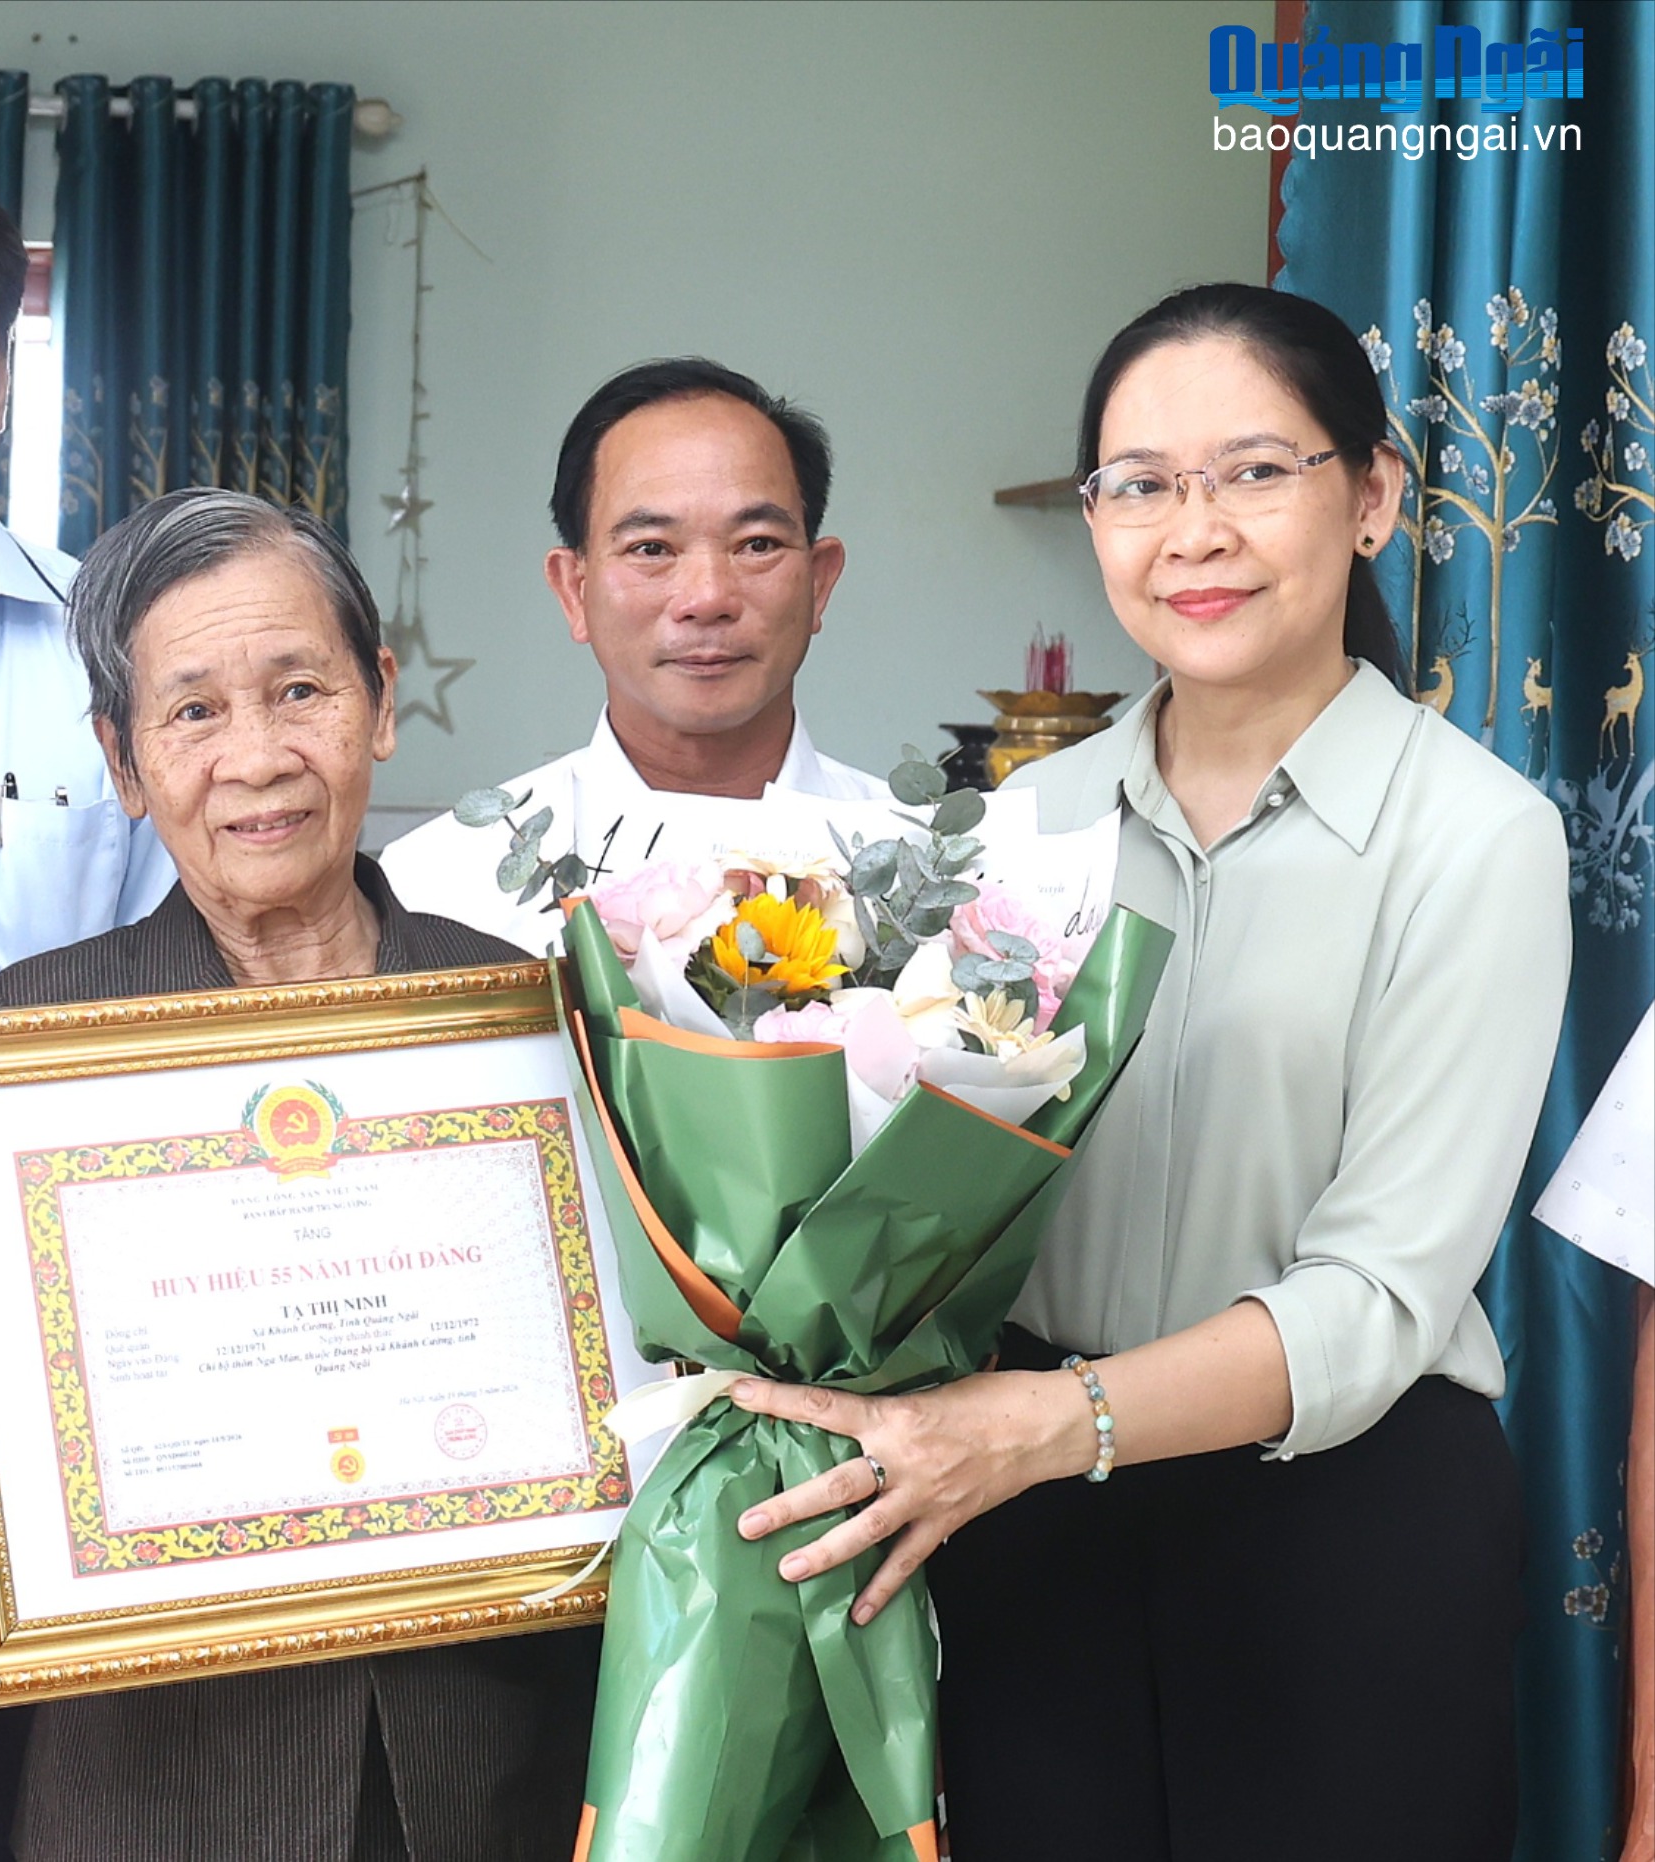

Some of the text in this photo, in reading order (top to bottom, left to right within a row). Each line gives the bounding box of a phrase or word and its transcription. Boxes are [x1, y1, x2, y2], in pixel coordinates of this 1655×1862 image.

[151, 1242, 483, 1298] HUY HIỆU 55 NĂM TUỔI ĐẢNG
[280, 1294, 388, 1321] TẠ THỊ NINH
[430, 1317, 480, 1332] 12/12/1972
[216, 1342, 267, 1356] 12/12/1971
